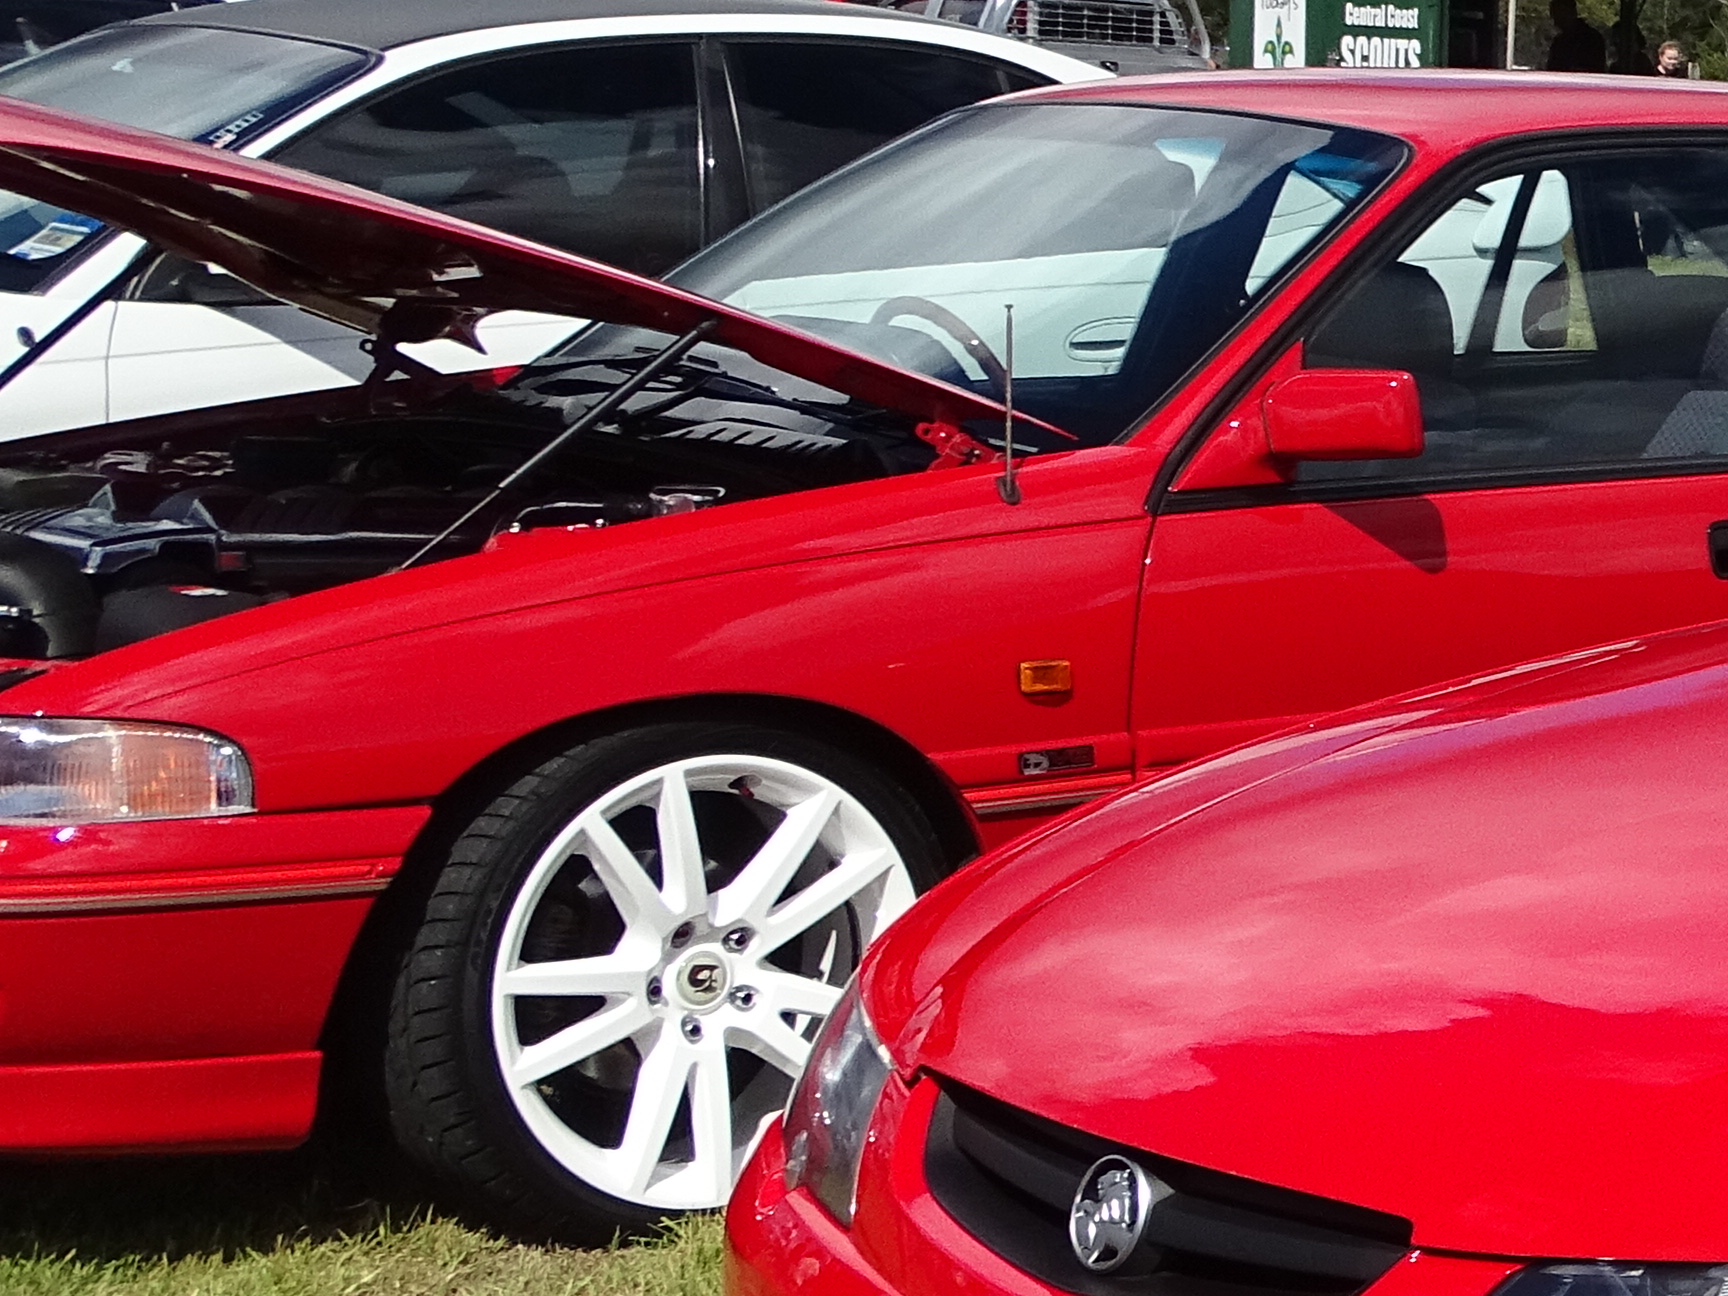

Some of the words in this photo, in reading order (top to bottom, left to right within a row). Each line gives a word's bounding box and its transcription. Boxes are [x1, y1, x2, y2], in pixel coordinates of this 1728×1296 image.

[1345, 1, 1386, 28] Central
[1387, 4, 1420, 29] Coast
[1340, 34, 1422, 68] SCOUTS
